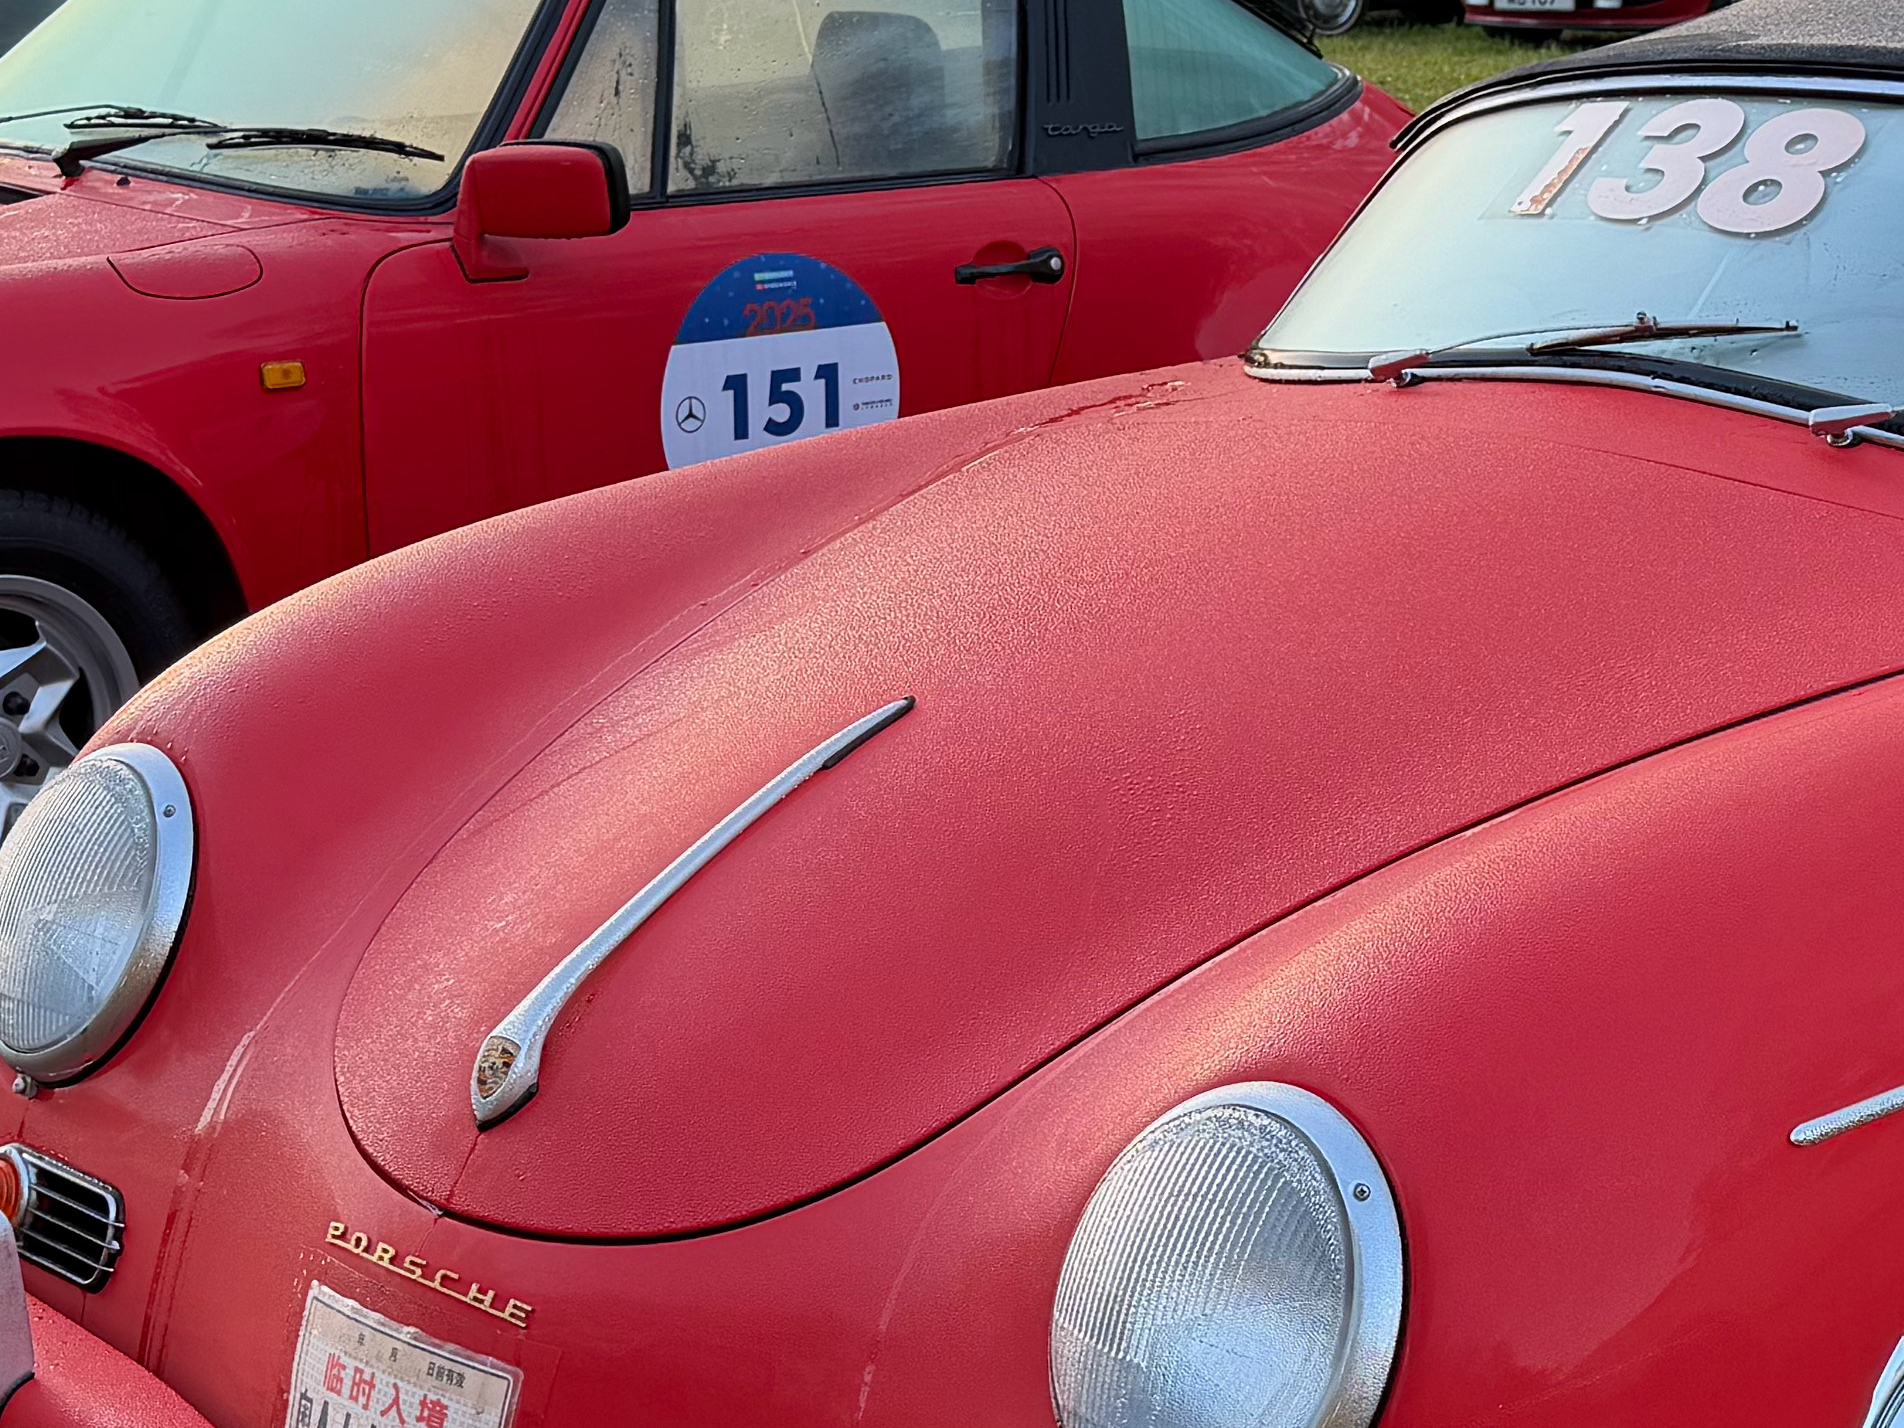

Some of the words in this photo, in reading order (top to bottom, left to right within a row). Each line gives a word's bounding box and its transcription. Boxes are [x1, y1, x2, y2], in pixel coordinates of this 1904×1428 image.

[1509, 98, 1867, 234] 138
[721, 361, 841, 442] 151
[324, 1220, 533, 1328] PORSCHE
